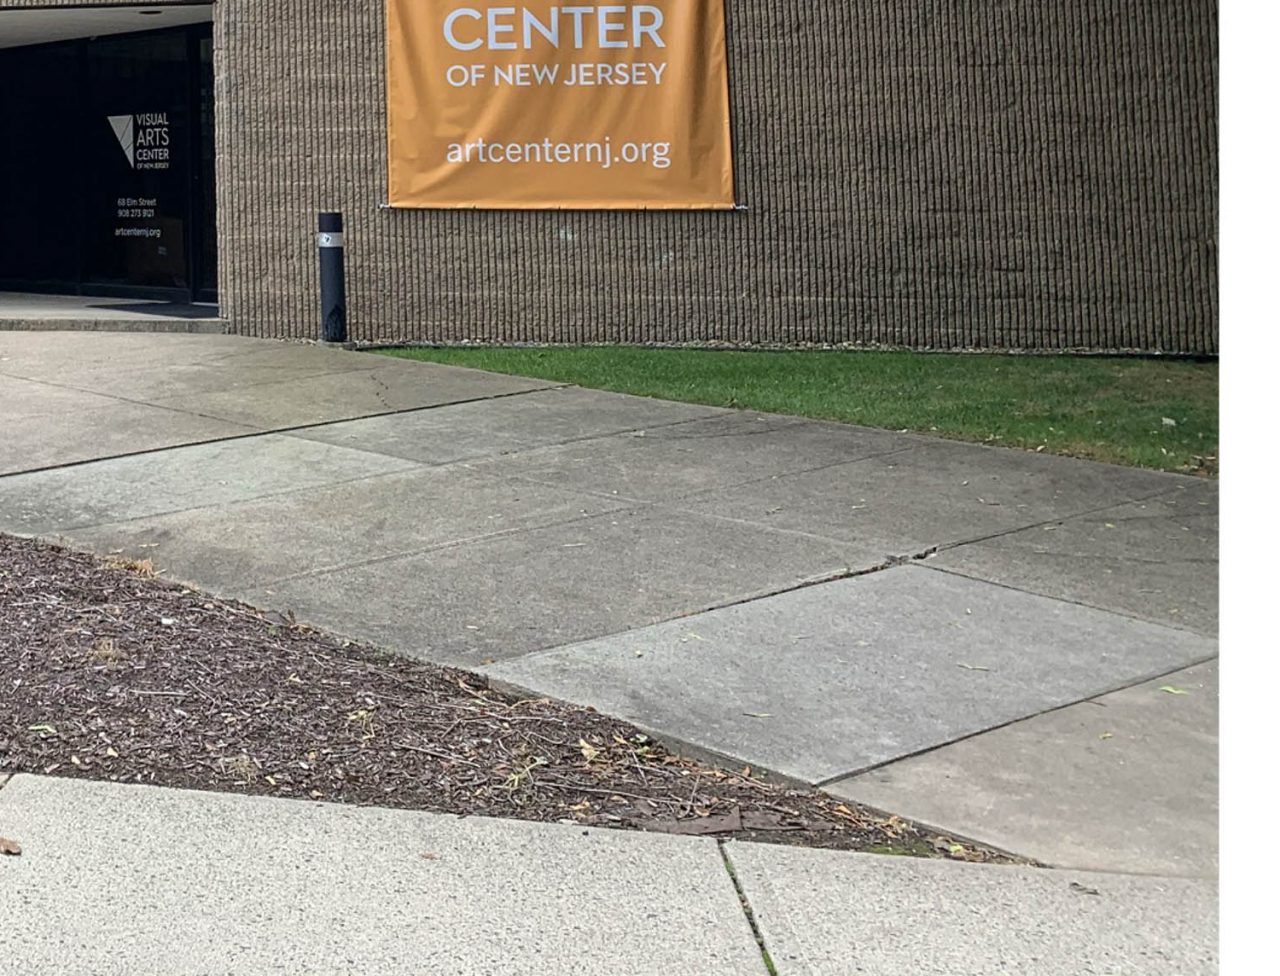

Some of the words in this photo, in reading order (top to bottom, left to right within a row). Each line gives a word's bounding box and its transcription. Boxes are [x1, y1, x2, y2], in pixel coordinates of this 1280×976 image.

[443, 5, 666, 52] CENTER
[446, 64, 486, 87] OF
[493, 63, 559, 86] NEW
[563, 62, 667, 86] JERSEY
[136, 112, 169, 126] VISUAL
[136, 127, 169, 146] ARTS
[136, 148, 169, 161] CENTER
[446, 137, 671, 169] artcenternj.org
[126, 197, 138, 207] Elm
[138, 197, 157, 207] Street
[130, 208, 141, 218] 273
[114, 227, 161, 238] artcenternj.org
